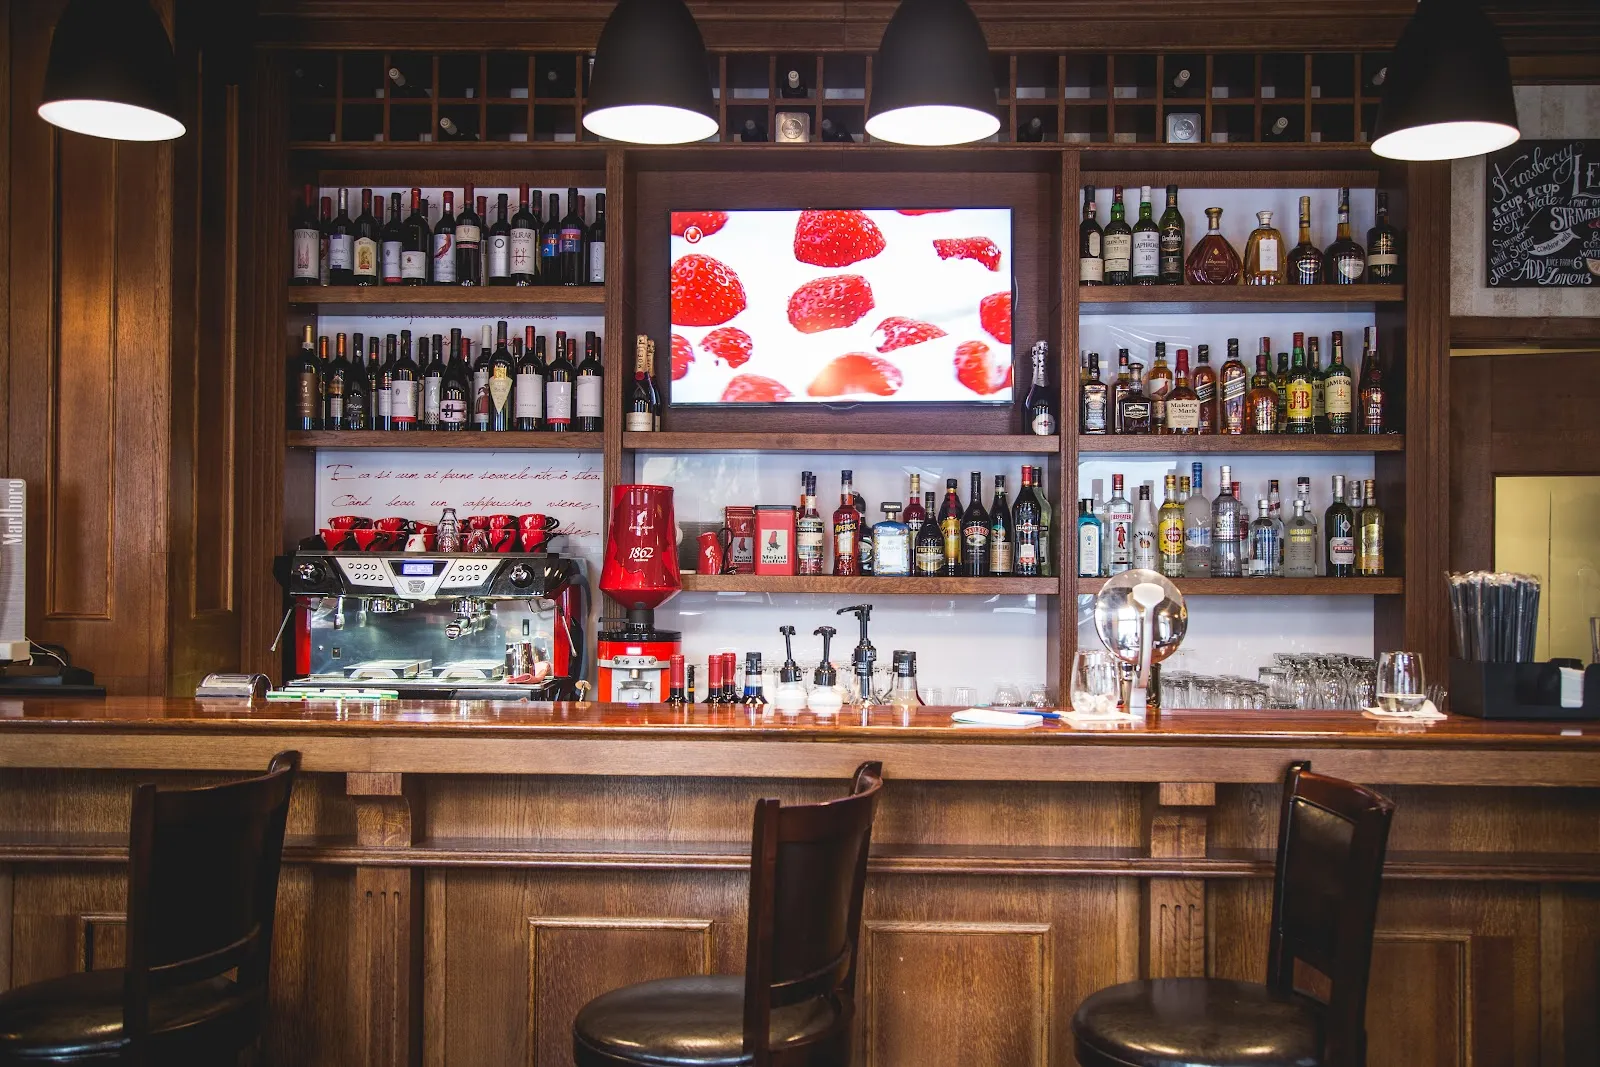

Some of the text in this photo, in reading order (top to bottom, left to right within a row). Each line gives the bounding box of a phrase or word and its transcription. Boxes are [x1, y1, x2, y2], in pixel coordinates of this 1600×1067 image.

[1326, 379, 1352, 388] JAMESON
[0, 480, 24, 545] Marlboro
[834, 522, 857, 533] APEROL
[1133, 530, 1157, 540] MALIBU
[629, 547, 654, 559] 1862
